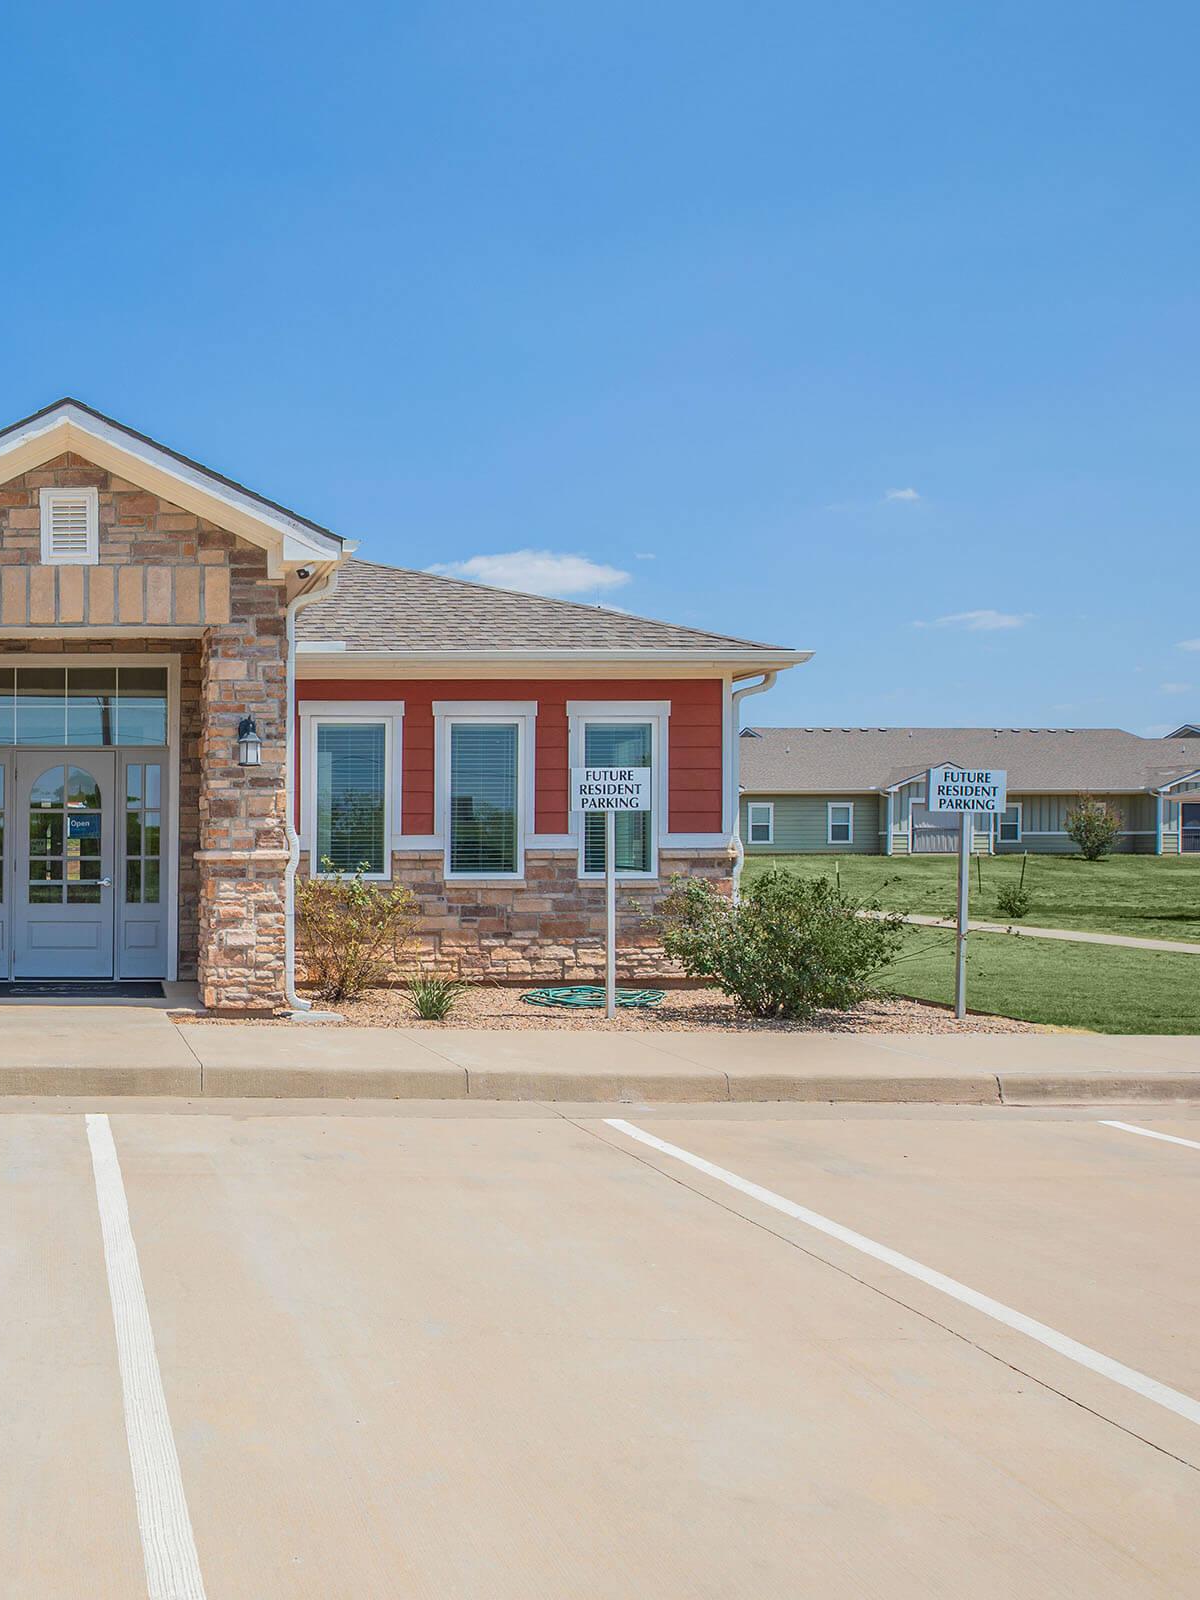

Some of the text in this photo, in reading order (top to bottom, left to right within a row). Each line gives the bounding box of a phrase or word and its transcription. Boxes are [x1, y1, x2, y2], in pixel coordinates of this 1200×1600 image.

[586, 770, 634, 781] FUTURE
[944, 771, 991, 783] FUTURE
[579, 783, 642, 795] RESIDENT
[937, 785, 999, 796] RESIDENT
[581, 797, 639, 808] PARKING
[939, 799, 995, 810] PARKING
[70, 820, 90, 828] Open
